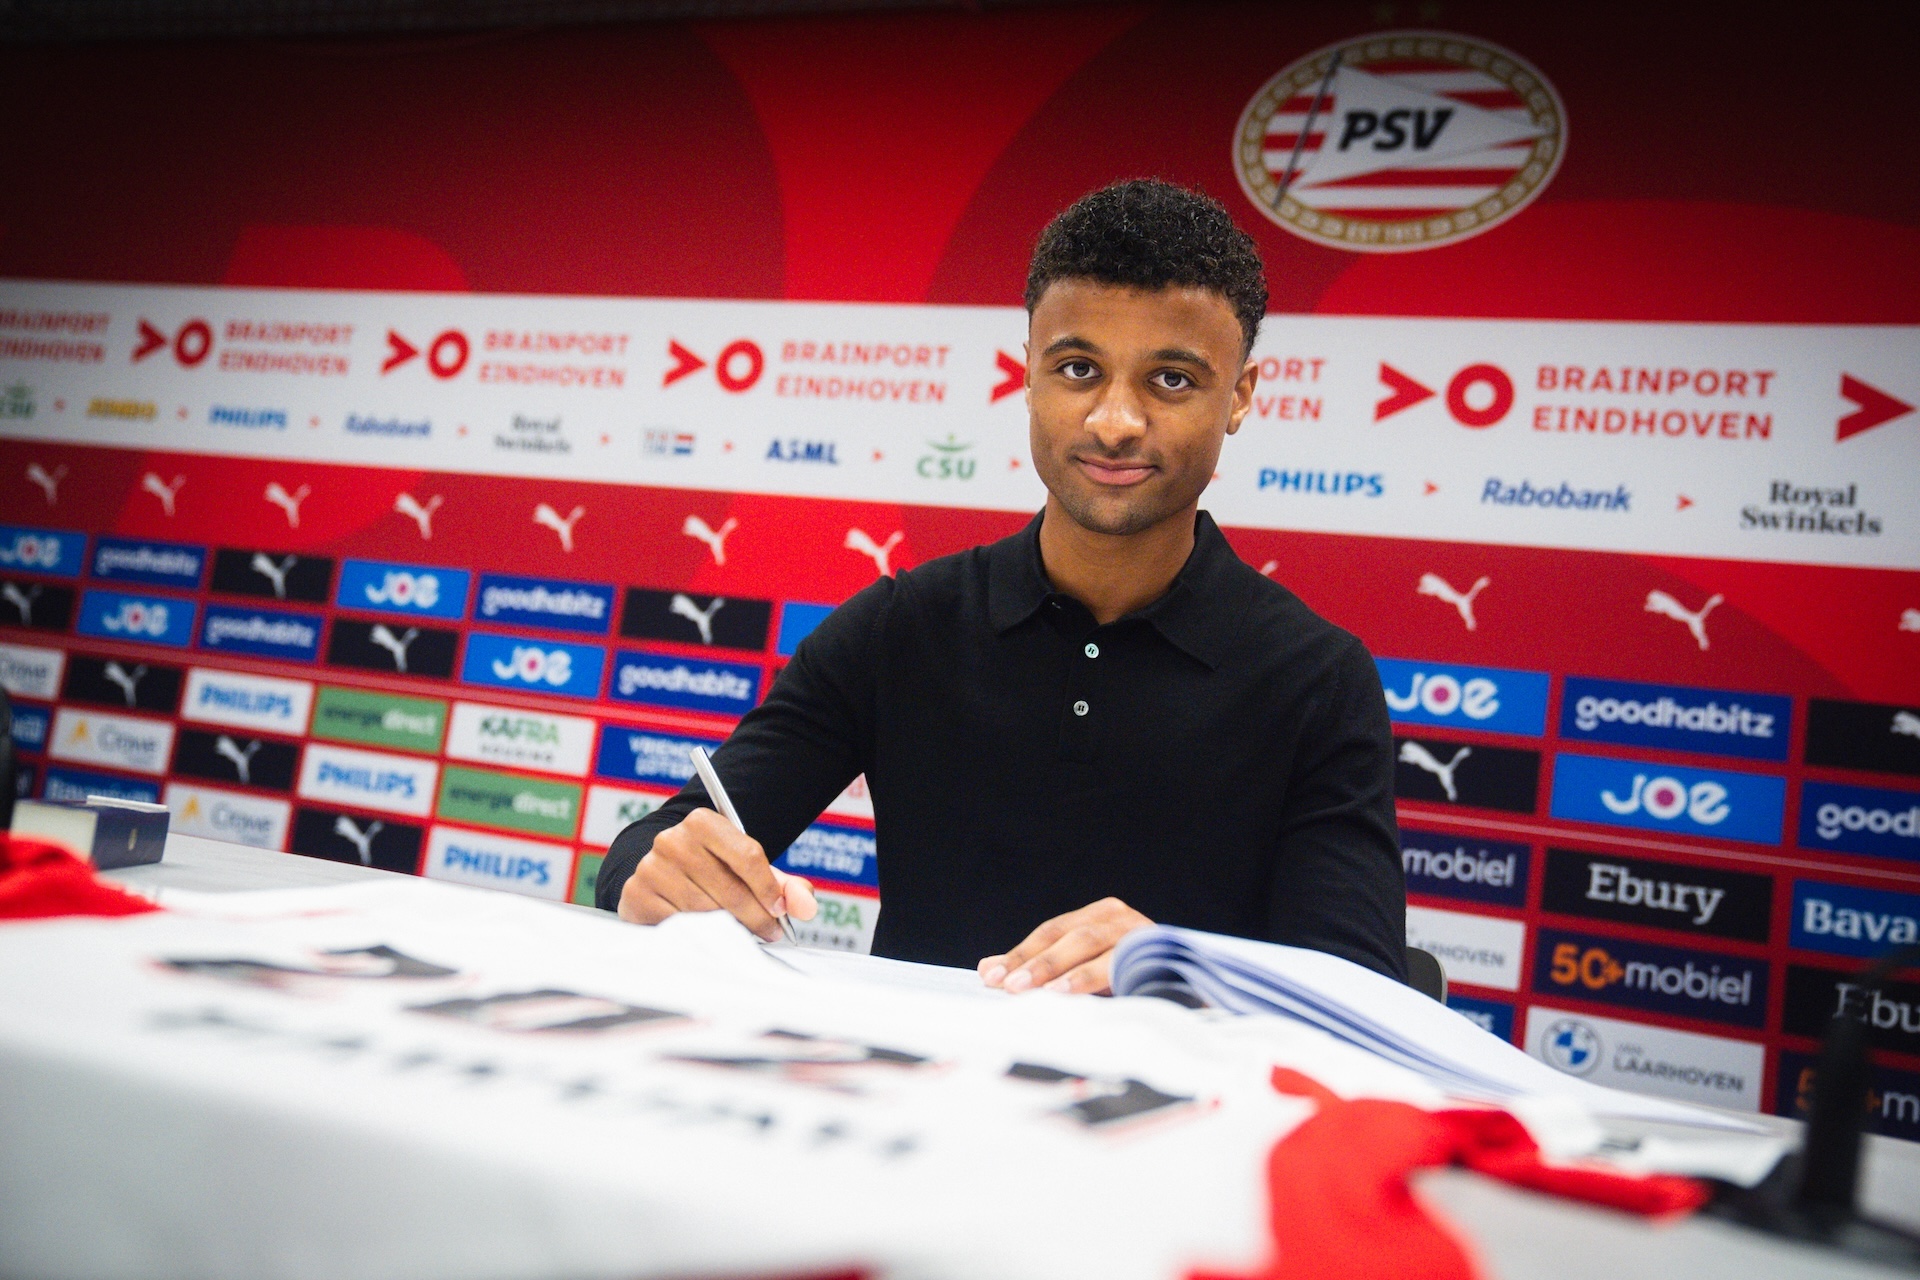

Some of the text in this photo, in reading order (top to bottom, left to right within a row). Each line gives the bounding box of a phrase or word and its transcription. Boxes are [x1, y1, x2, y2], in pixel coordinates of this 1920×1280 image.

[1339, 107, 1455, 152] PSV
[225, 320, 354, 344] BRAINPORT
[483, 329, 629, 356] BRAINPORT
[218, 350, 348, 375] EINDHOVEN
[780, 341, 951, 369] BRAINPORT
[478, 362, 626, 388] EINDHOVEN
[776, 375, 946, 402] EINDHOVEN
[1537, 365, 1776, 399] BRAINPORT
[1532, 407, 1773, 440] EINDHOVEN
[765, 438, 839, 465] ASML
[916, 453, 976, 479] CSU
[1258, 467, 1385, 498] PHILIPS
[1481, 477, 1631, 513] Rabobank
[1768, 480, 1858, 509] Royal
[1739, 505, 1882, 537] Swinkels
[480, 584, 606, 620] goodhabitz
[618, 663, 752, 700] goodhabitz
[200, 683, 293, 717] PHILIPS
[478, 715, 561, 746] KAFRA
[1576, 697, 1773, 738] goodhabitz
[317, 761, 417, 799] PHILIPS
[1816, 803, 1920, 840] good
[444, 845, 550, 885] PHILIPS
[1402, 847, 1516, 887] mobiel
[1586, 862, 1724, 925] Ebury
[1803, 898, 1920, 943] Bava
[1613, 1053, 1746, 1093] LAARHOVEN
